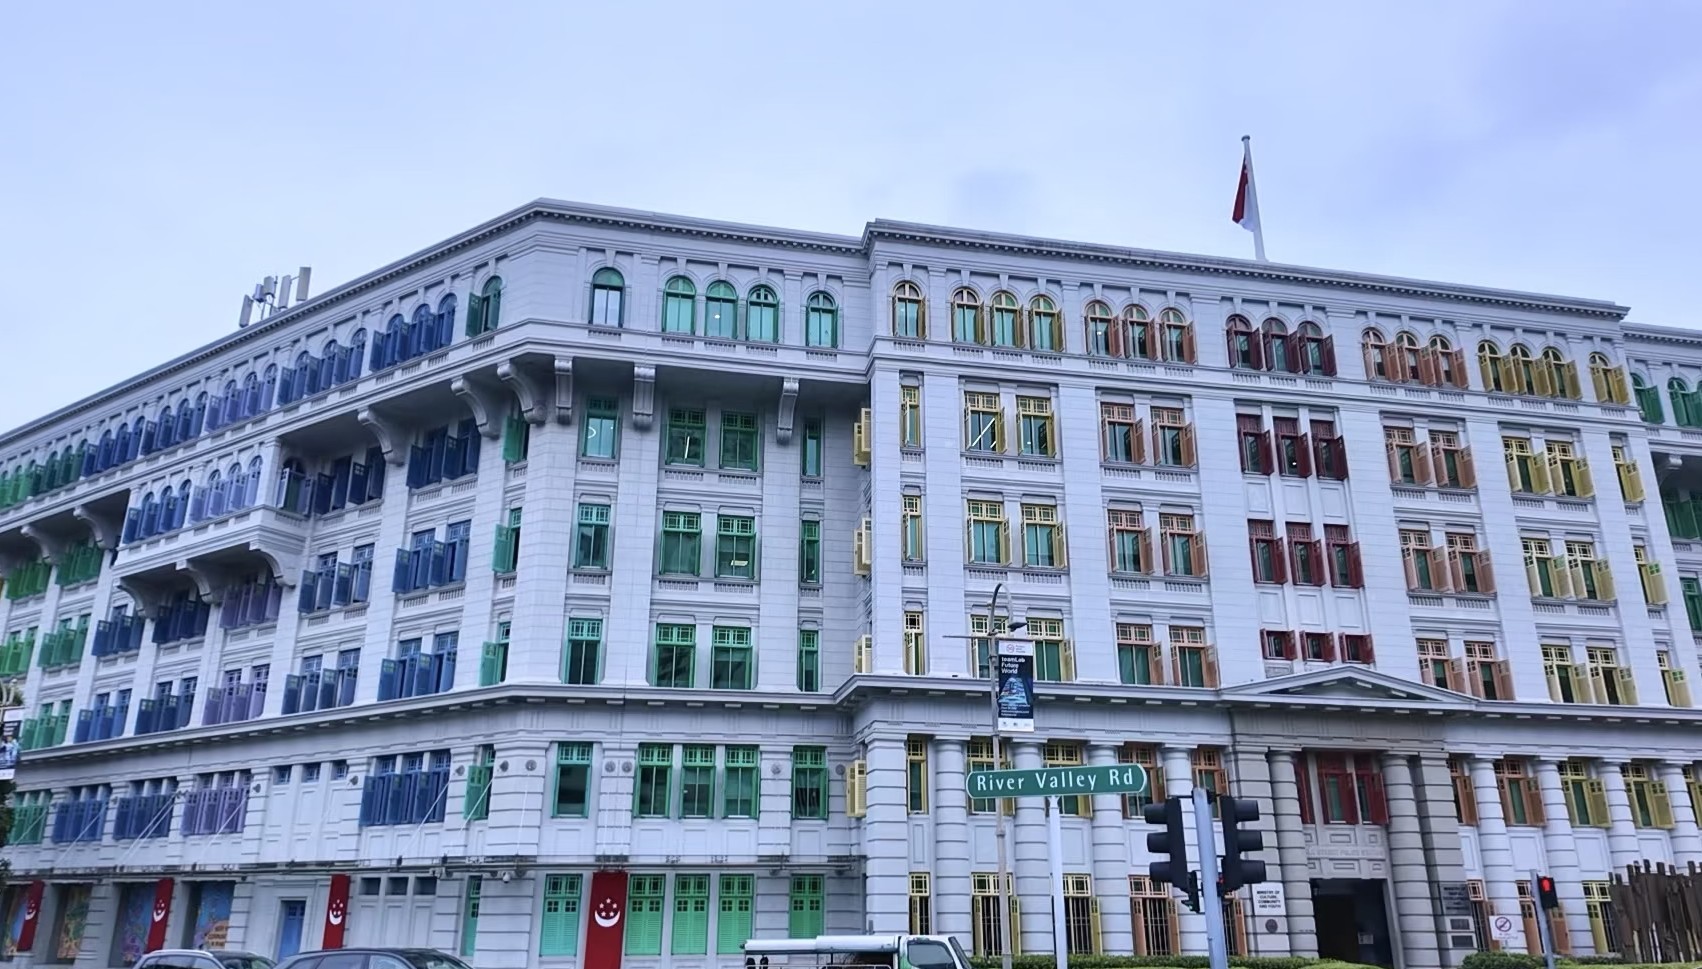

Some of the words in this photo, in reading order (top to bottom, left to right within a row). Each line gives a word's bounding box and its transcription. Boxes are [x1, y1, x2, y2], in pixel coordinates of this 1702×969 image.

[977, 774, 1025, 791] River
[1035, 771, 1097, 791] Valley
[1109, 768, 1133, 786] Rd
